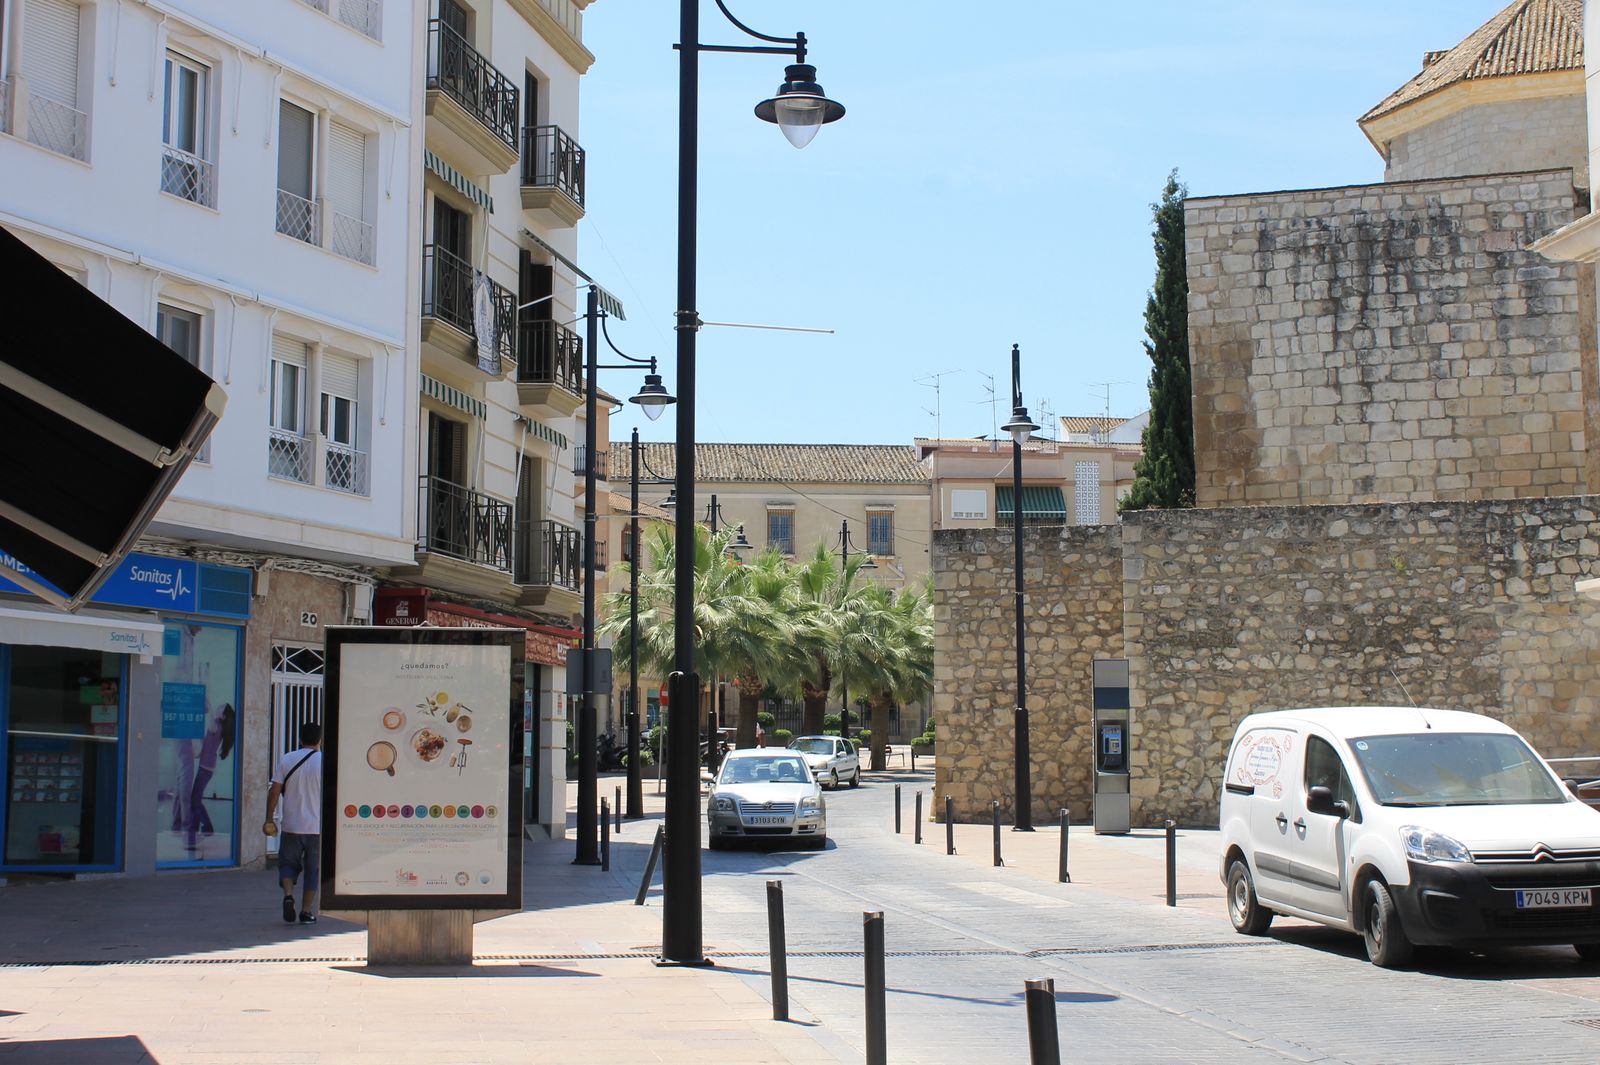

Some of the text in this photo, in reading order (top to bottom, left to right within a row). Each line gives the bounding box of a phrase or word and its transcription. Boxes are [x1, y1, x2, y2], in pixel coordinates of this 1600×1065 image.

[130, 566, 172, 585] Sanitas
[302, 613, 317, 625] 20
[386, 617, 419, 625] GENERALI
[110, 632, 138, 642] Sanitas
[754, 816, 771, 824] 3103
[1525, 891, 1589, 905] 7049 KPM
